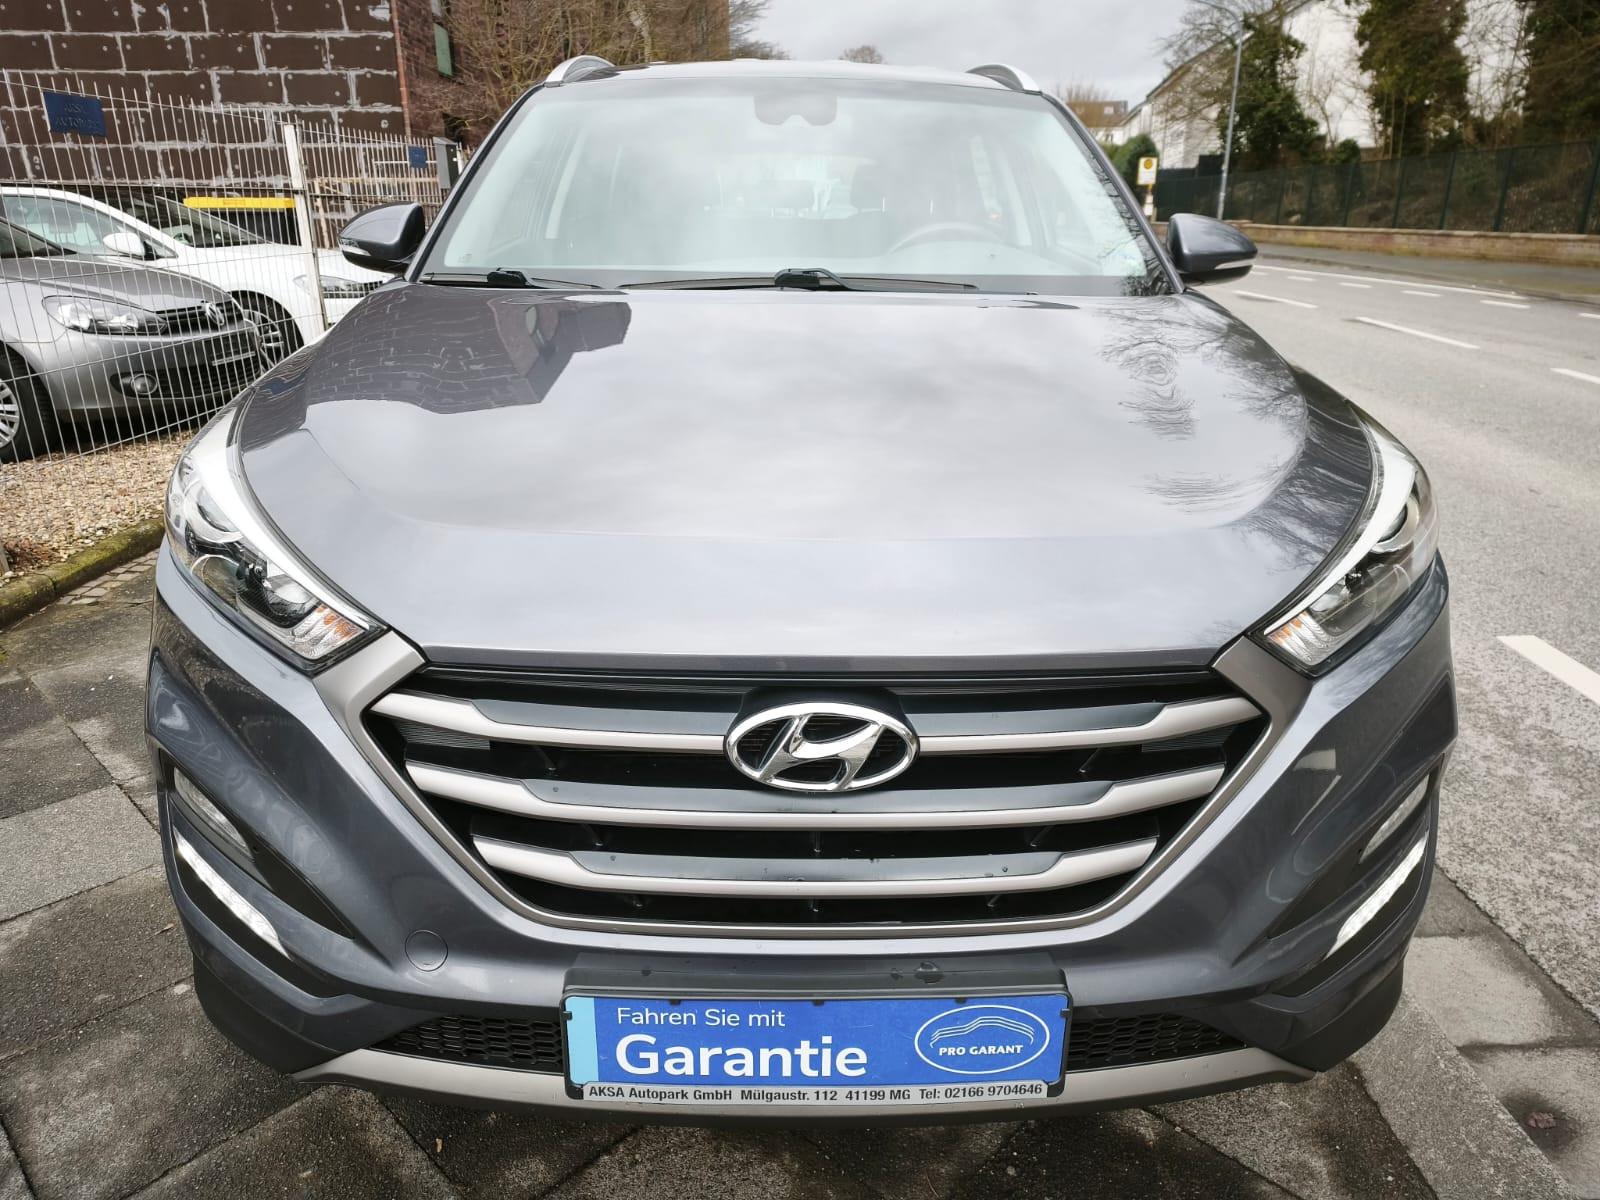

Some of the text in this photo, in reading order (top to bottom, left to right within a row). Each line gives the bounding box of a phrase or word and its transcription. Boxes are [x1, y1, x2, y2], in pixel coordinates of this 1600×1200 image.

[617, 1007, 786, 1027] Fahren Sie mit
[615, 1033, 868, 1077] Garantie
[939, 1044, 1024, 1056] PRO GARANT
[588, 1082, 1043, 1103] AKSA Autopark GmbH Mülgaustr. 112 41199 MG Tel: 02166 9704646
